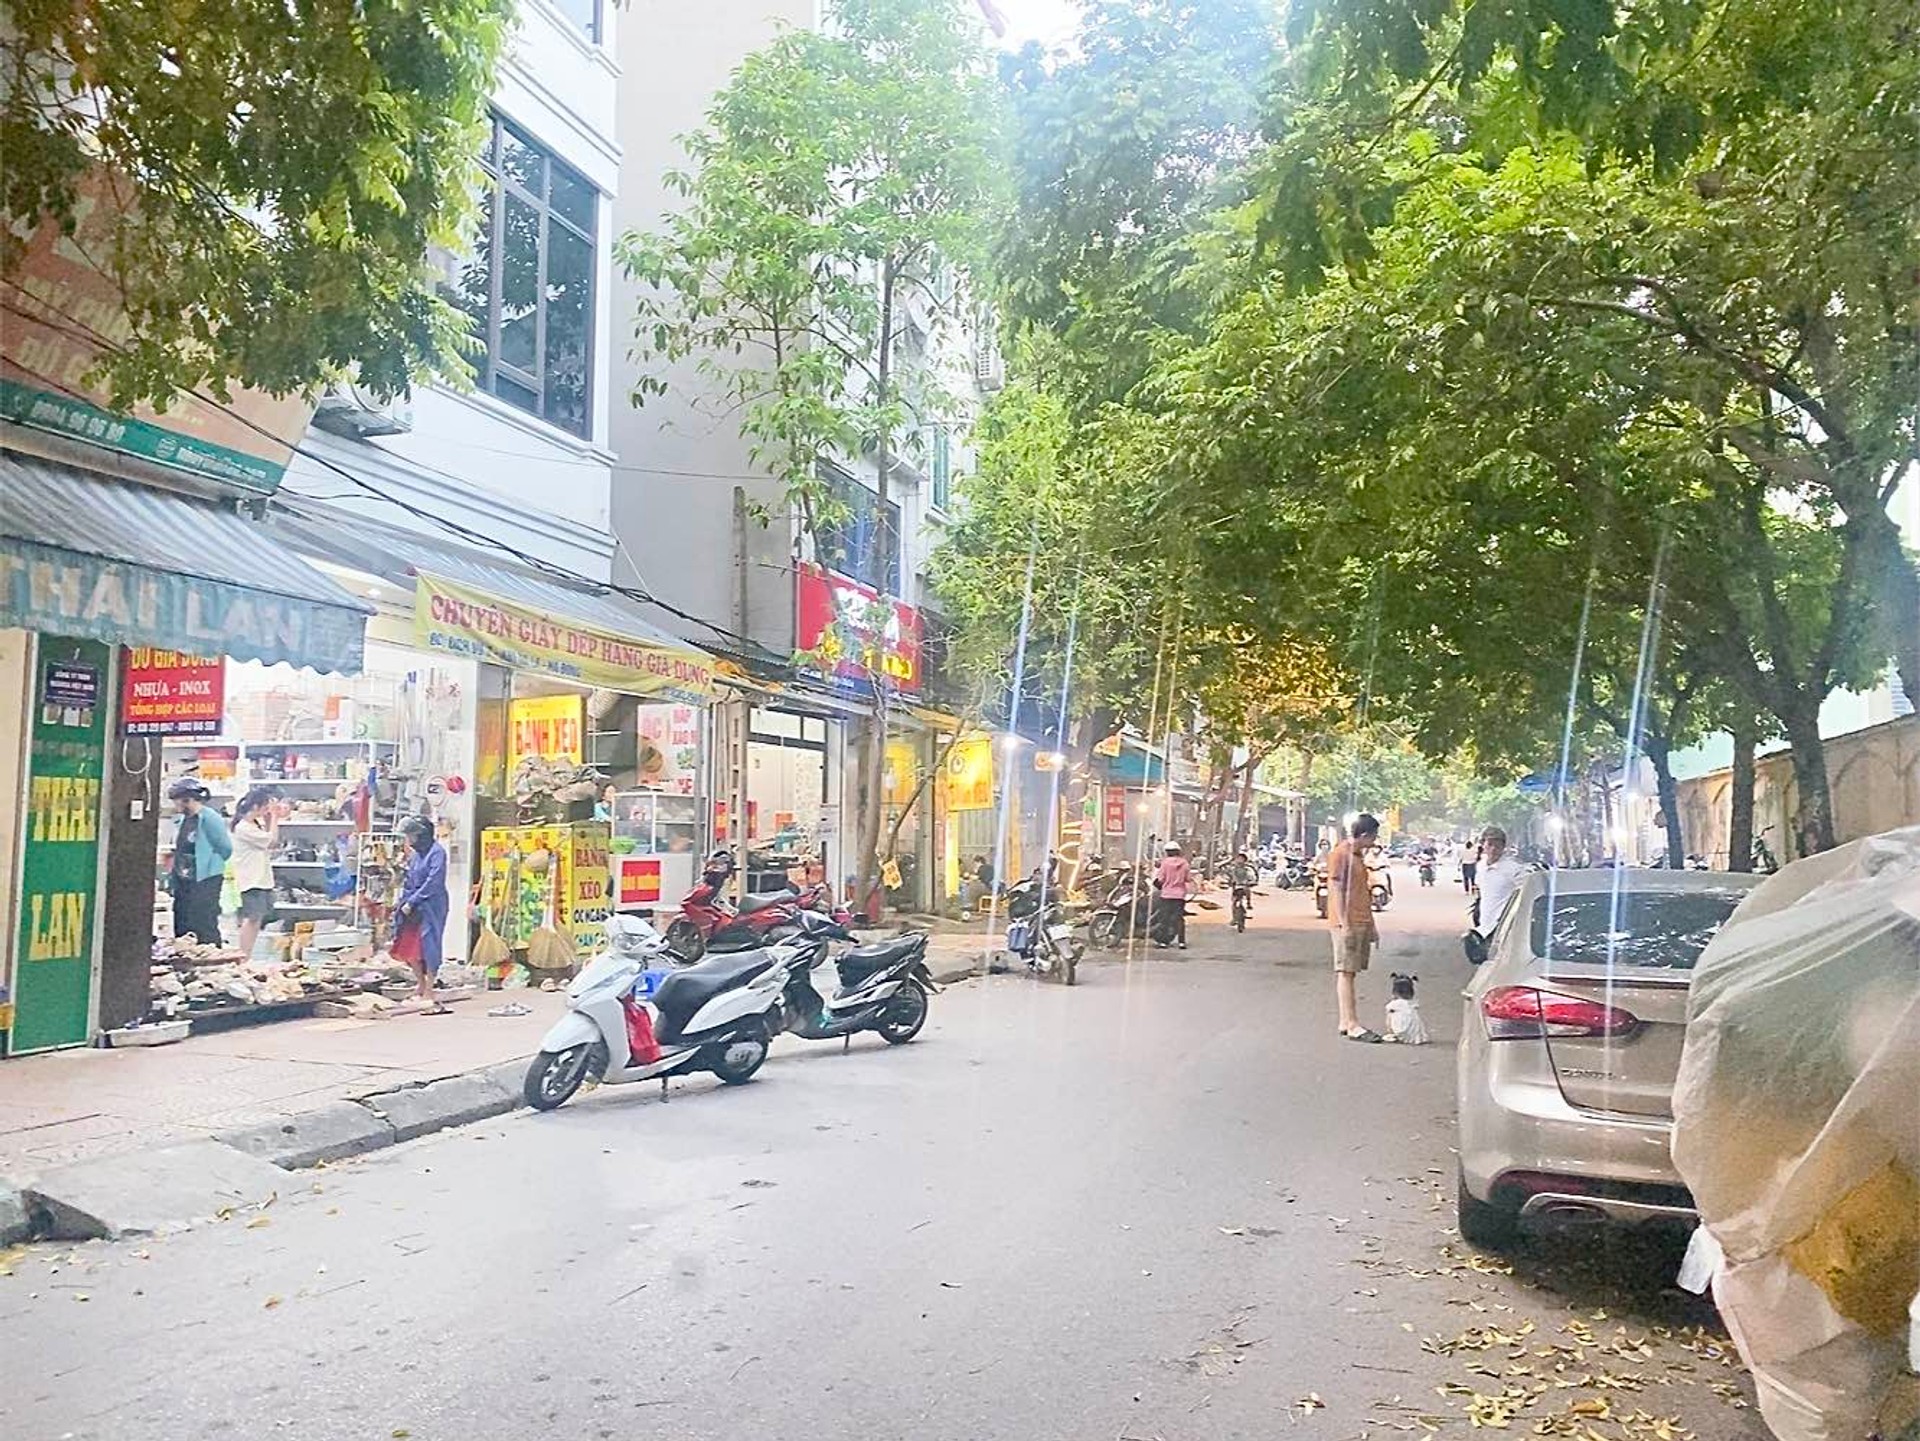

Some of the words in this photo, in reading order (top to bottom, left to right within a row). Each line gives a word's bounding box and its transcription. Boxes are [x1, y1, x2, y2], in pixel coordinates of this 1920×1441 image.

[430, 594, 513, 638] CHUYÊN
[134, 680, 170, 700] NHỰA
[179, 680, 211, 696] INOX
[28, 892, 87, 962] LAN
